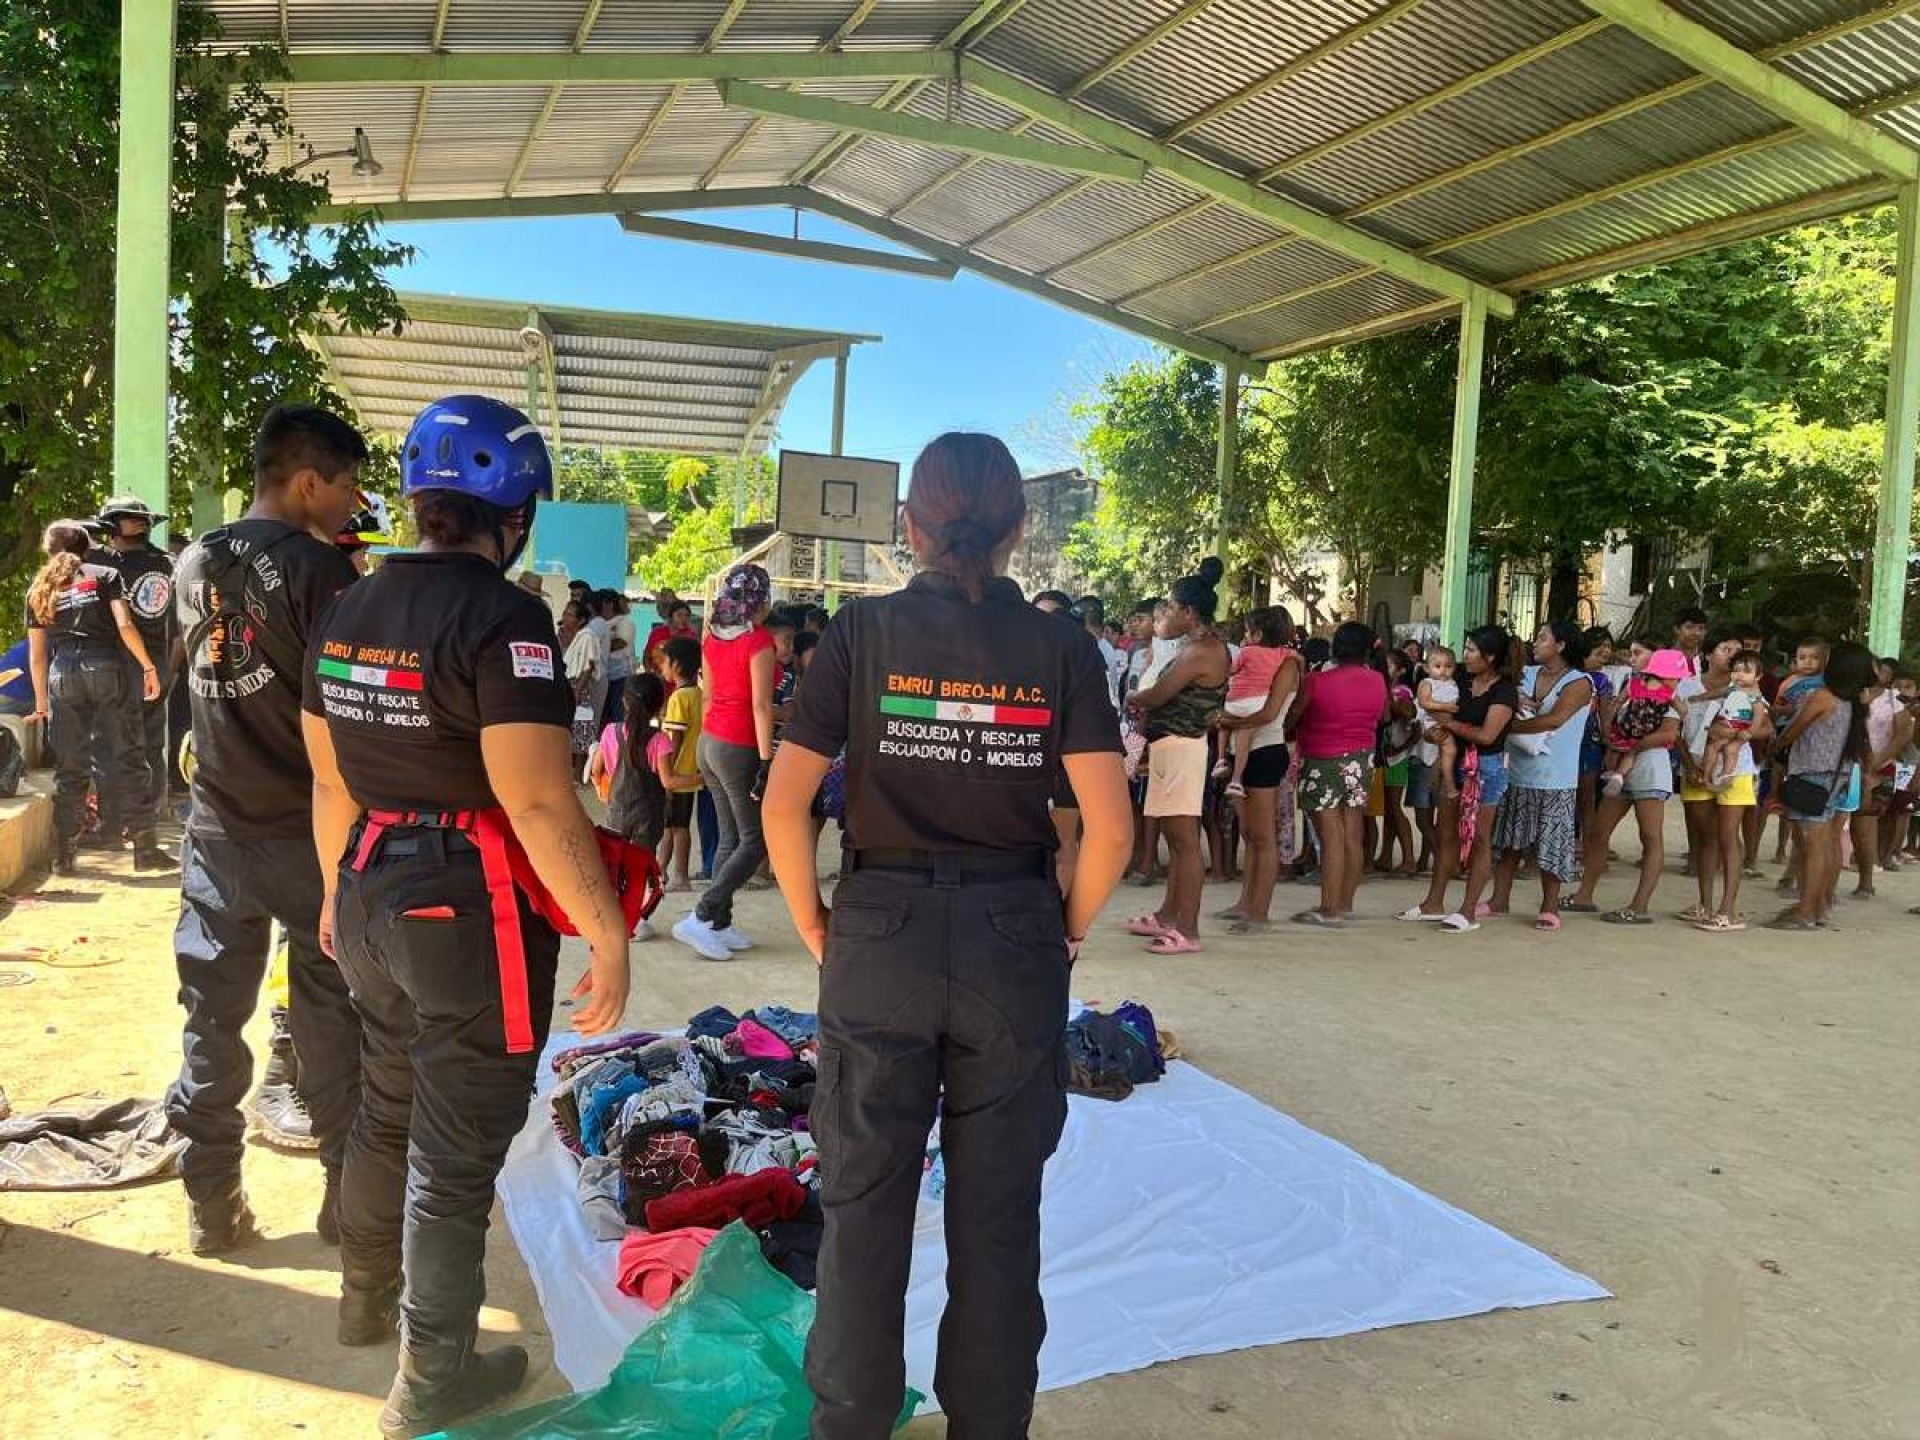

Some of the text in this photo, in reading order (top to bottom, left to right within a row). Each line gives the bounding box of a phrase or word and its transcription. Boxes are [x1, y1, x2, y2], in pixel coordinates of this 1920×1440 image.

[398, 651, 420, 668] A.C.
[368, 692, 375, 704] Y
[887, 675, 1046, 703] EMRU BREO-M A.C.
[887, 720, 1041, 746] BÚSQUEDA Y RESCATE
[879, 741, 957, 761] ESCUADRON
[987, 751, 1043, 767] MORELOS
